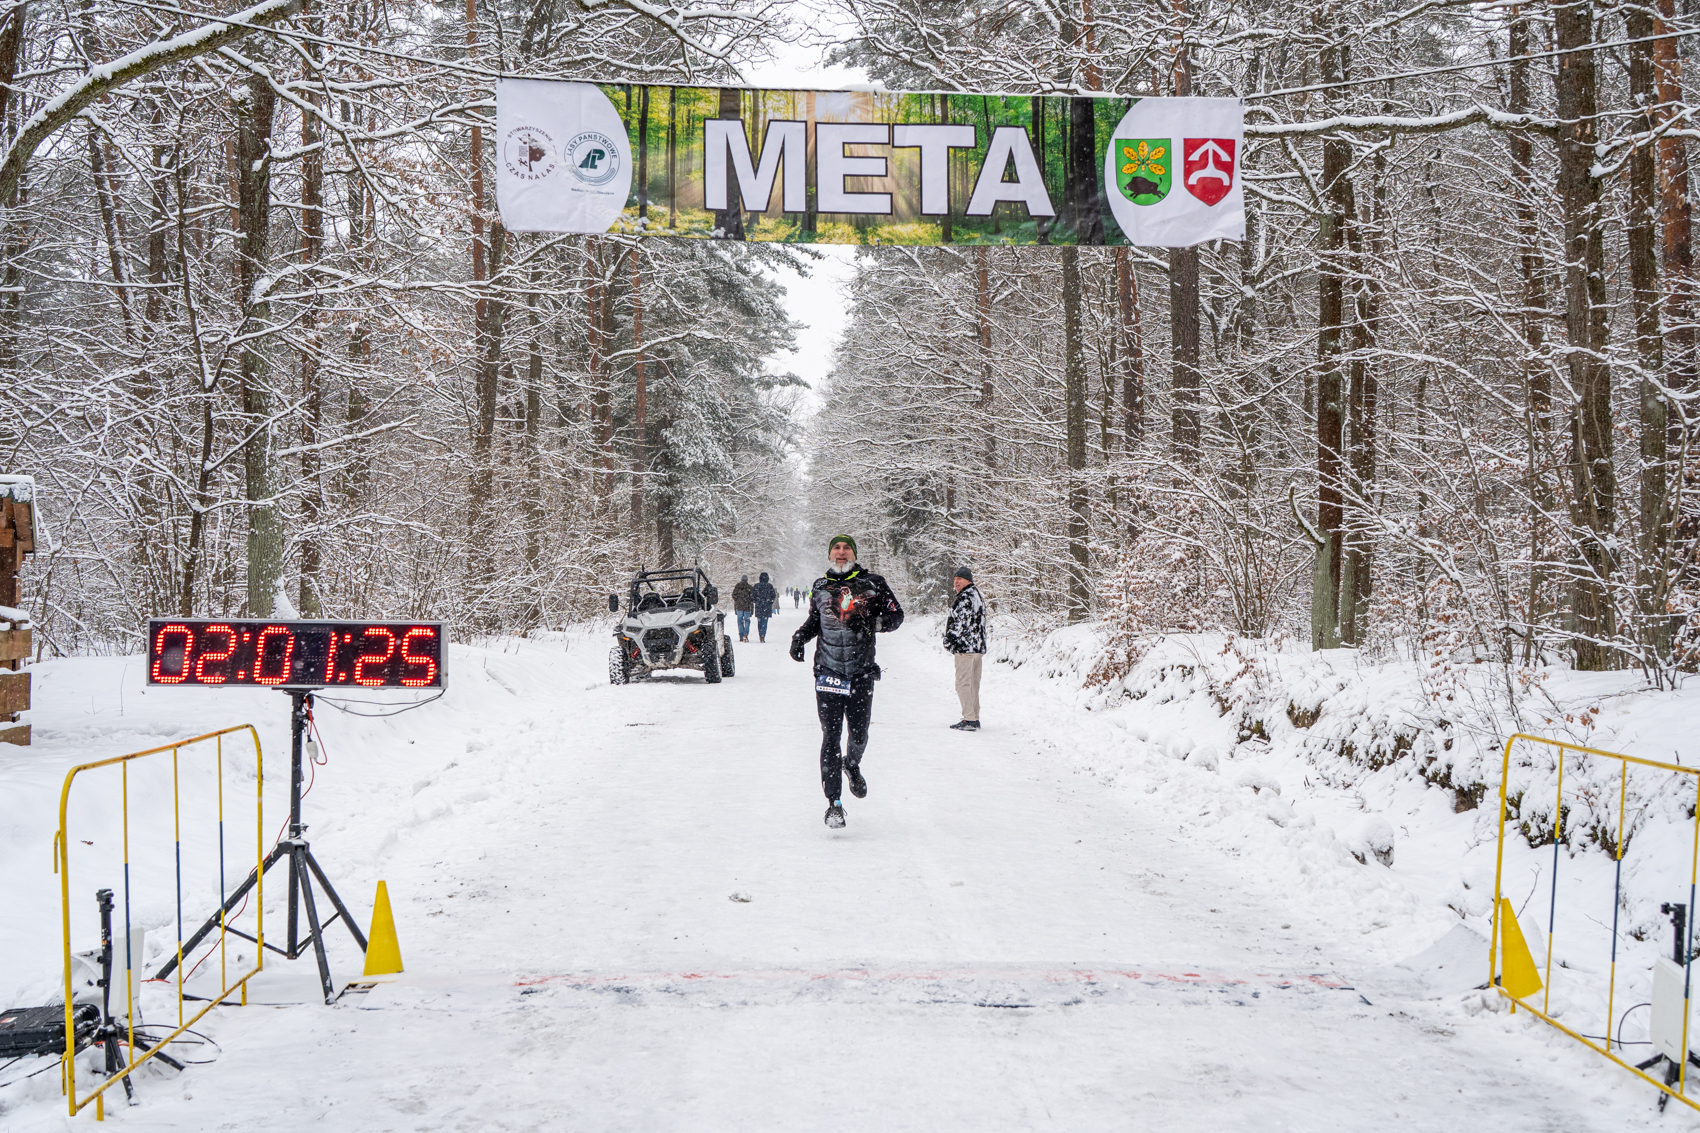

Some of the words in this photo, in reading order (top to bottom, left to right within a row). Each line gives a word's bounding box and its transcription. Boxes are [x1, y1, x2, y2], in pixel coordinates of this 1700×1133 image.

[507, 126, 553, 142] STOWARZYSZENIE
[567, 139, 578, 156] LASY
[505, 162, 525, 179] CZAS
[541, 163, 555, 177] LAS
[703, 118, 1055, 217] META
[152, 625, 436, 686] 02:01:25
